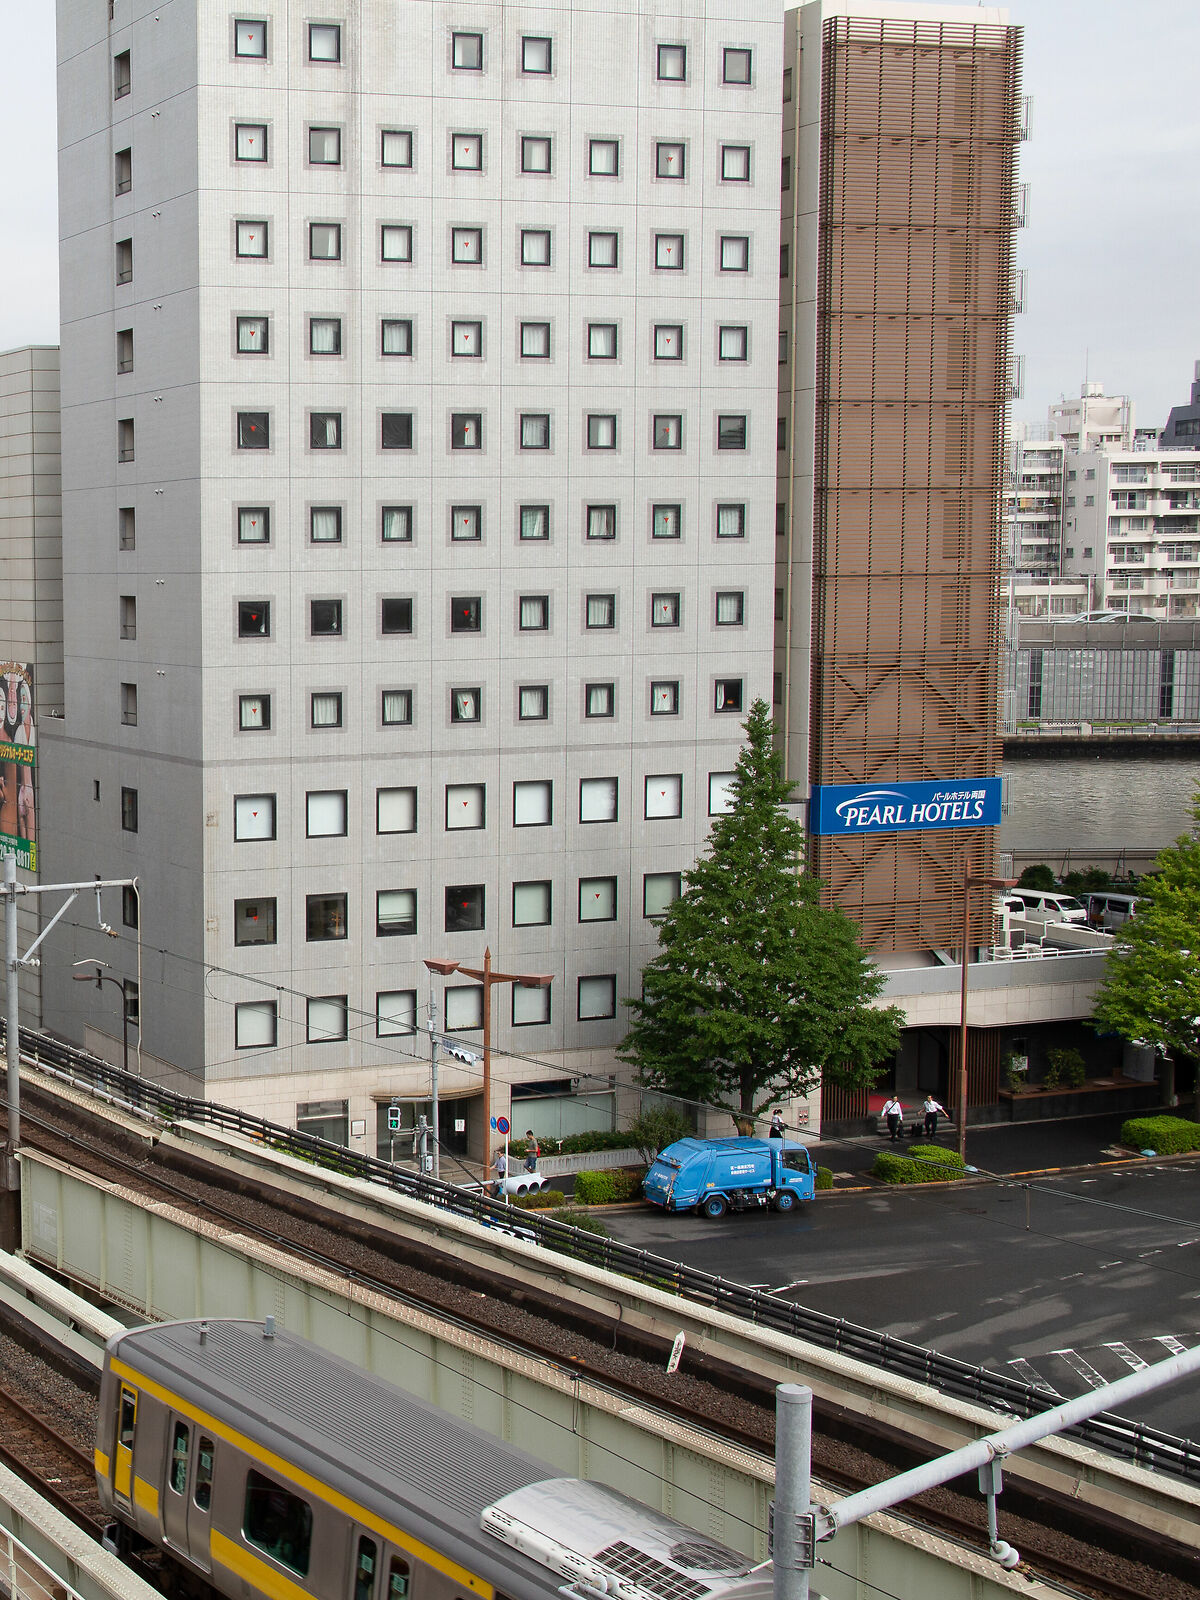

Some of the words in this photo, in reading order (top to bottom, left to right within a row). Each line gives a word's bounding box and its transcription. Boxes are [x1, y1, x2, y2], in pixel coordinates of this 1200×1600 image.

[932, 789, 987, 802] パールホテル両国
[843, 804, 907, 827] PEARL
[910, 800, 985, 823] HOTELS
